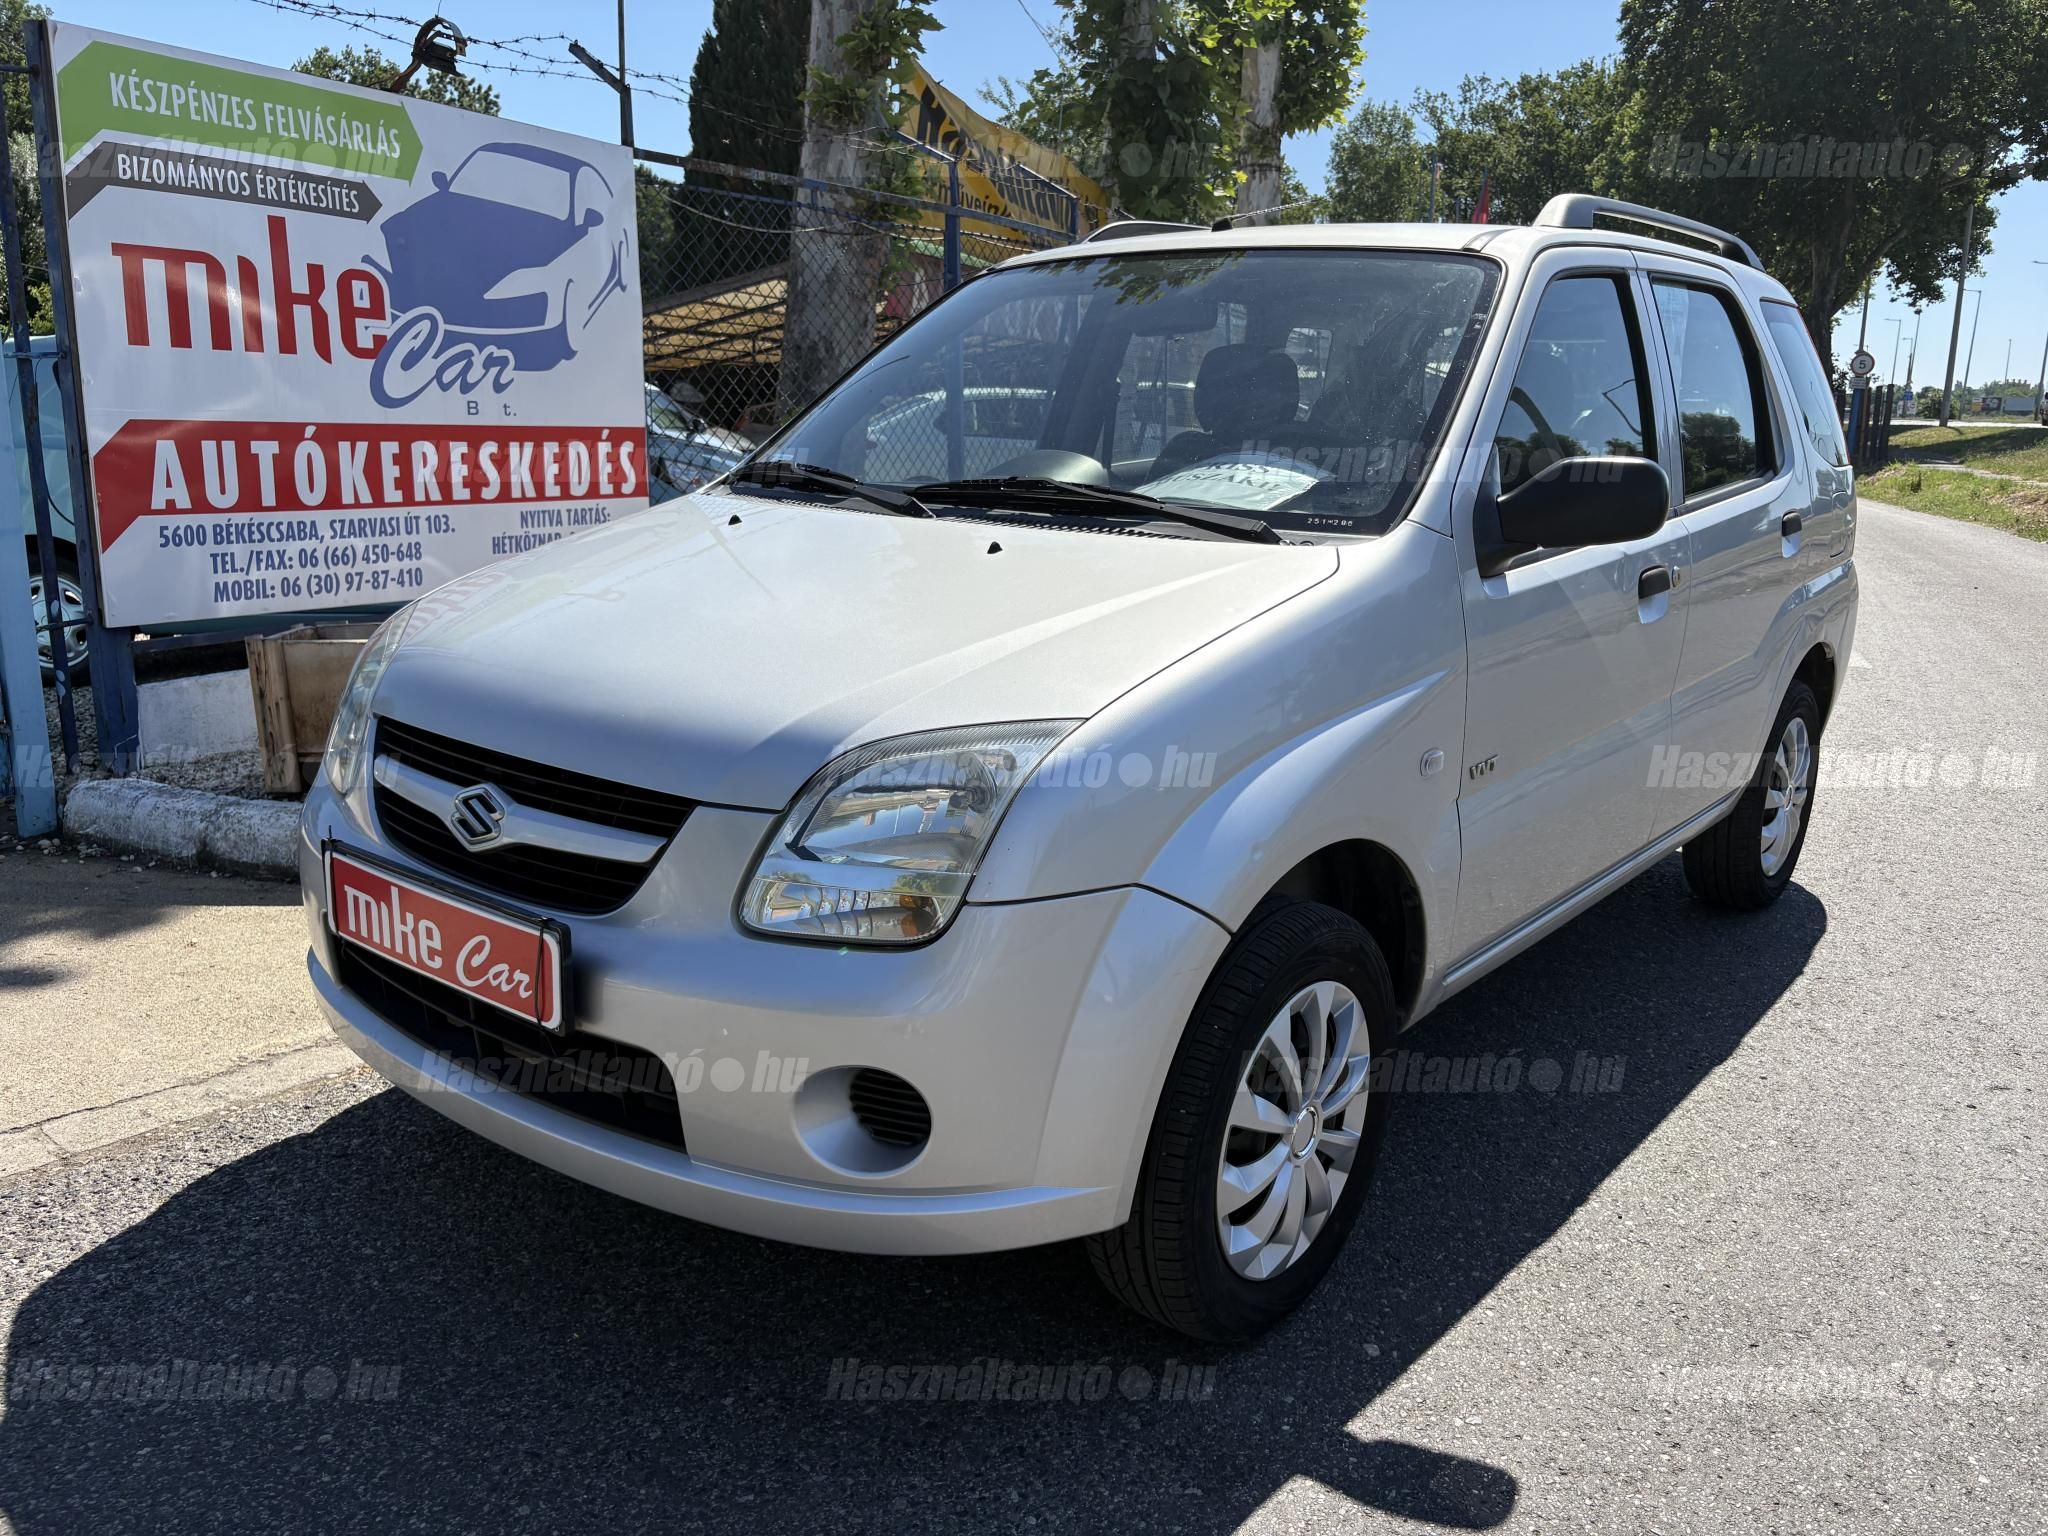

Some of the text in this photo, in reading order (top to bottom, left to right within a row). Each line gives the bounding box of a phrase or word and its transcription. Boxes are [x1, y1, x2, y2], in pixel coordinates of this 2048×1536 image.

[109, 69, 401, 159] KÉSZPÉNZES FELVÁSÁRLÁS
[117, 154, 360, 213] BIZOMÁNYOS ÉRTÉKESÍTÉS
[111, 214, 388, 364] mike
[369, 306, 515, 408] Car
[1858, 360, 1867, 370] 5
[151, 426, 636, 510] AUTÓKERESKEDÉS
[159, 512, 456, 548] 5600 BÉKÉSCSABA, SZARVASI ÚT 103.
[520, 503, 611, 529] NYITVA TARTÁS:
[210, 542, 422, 575] TEL./FAX: 06 (66) 450-648
[213, 567, 423, 603] MOBIL: 06 (30) 97-87-410
[344, 884, 533, 999] mike Car
